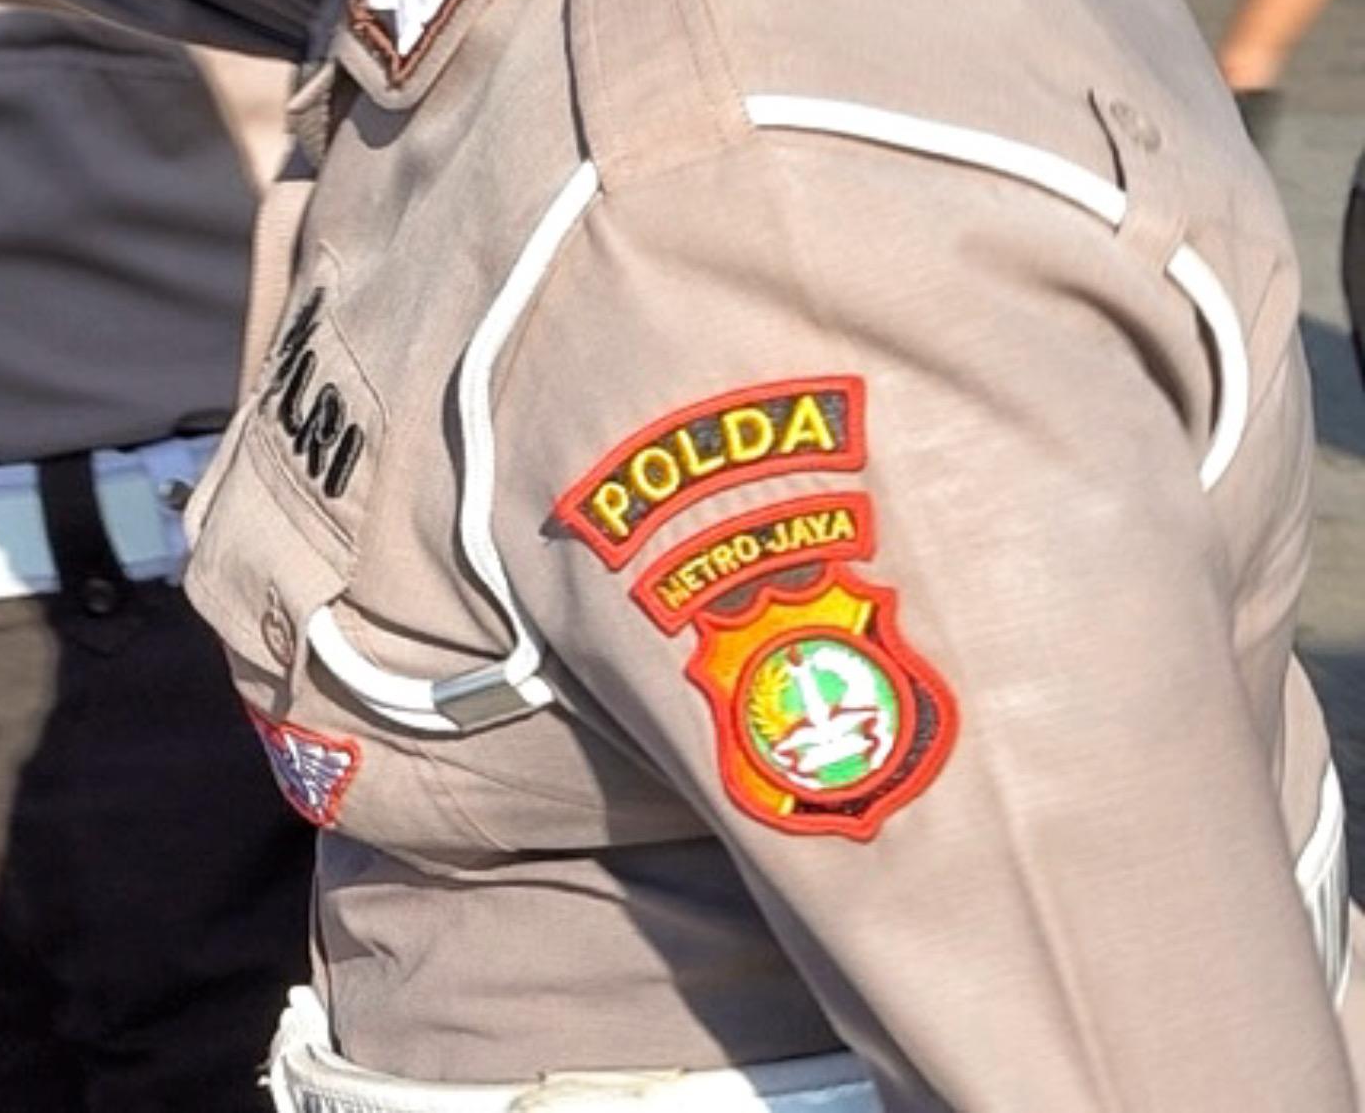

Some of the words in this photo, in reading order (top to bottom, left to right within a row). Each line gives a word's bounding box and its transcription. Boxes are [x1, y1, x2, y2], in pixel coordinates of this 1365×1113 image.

[274, 287, 365, 500] LRI
[590, 395, 836, 538] POLDA
[655, 533, 761, 610] METRO
[765, 508, 856, 554] JAYA
